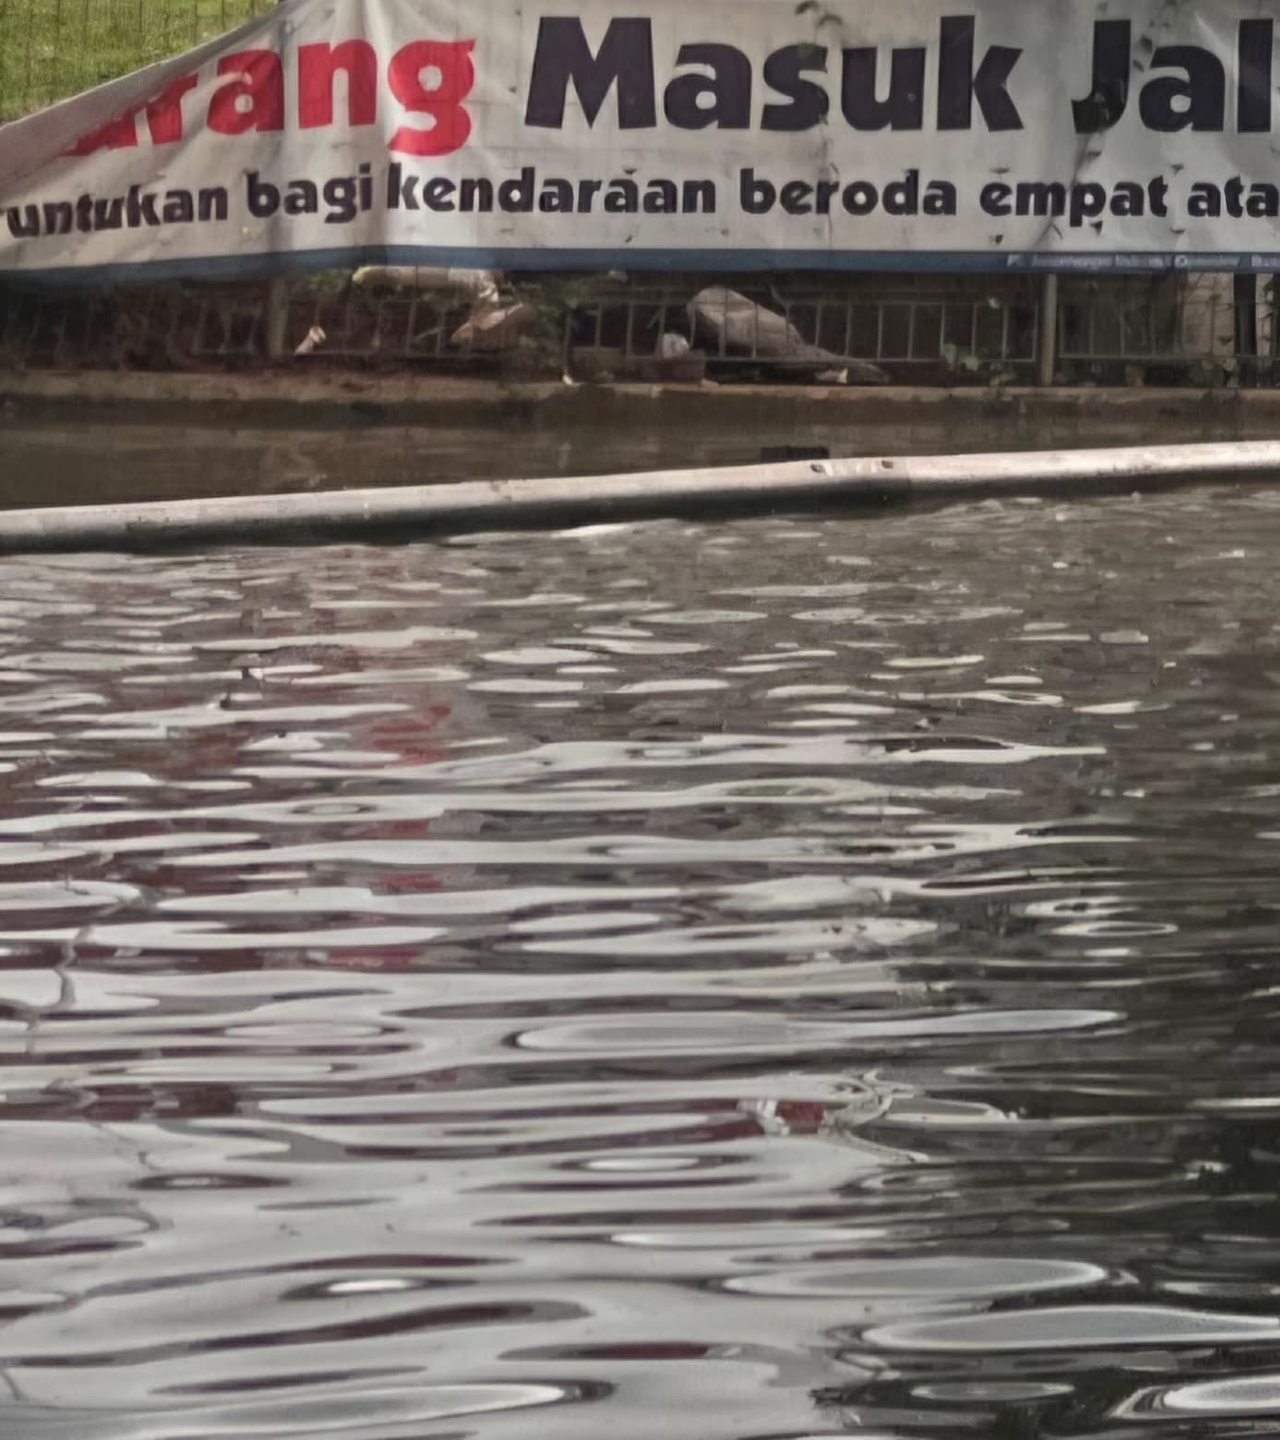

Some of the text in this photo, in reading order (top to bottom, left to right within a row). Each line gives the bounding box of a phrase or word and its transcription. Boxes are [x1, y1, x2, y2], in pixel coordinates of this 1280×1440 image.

[524, 15, 1023, 132] Masuk
[0, 184, 228, 240] untukan
[246, 164, 373, 224] bagi
[387, 162, 716, 215] kendaraan
[739, 168, 956, 218] beroda
[979, 176, 1168, 227] empat
